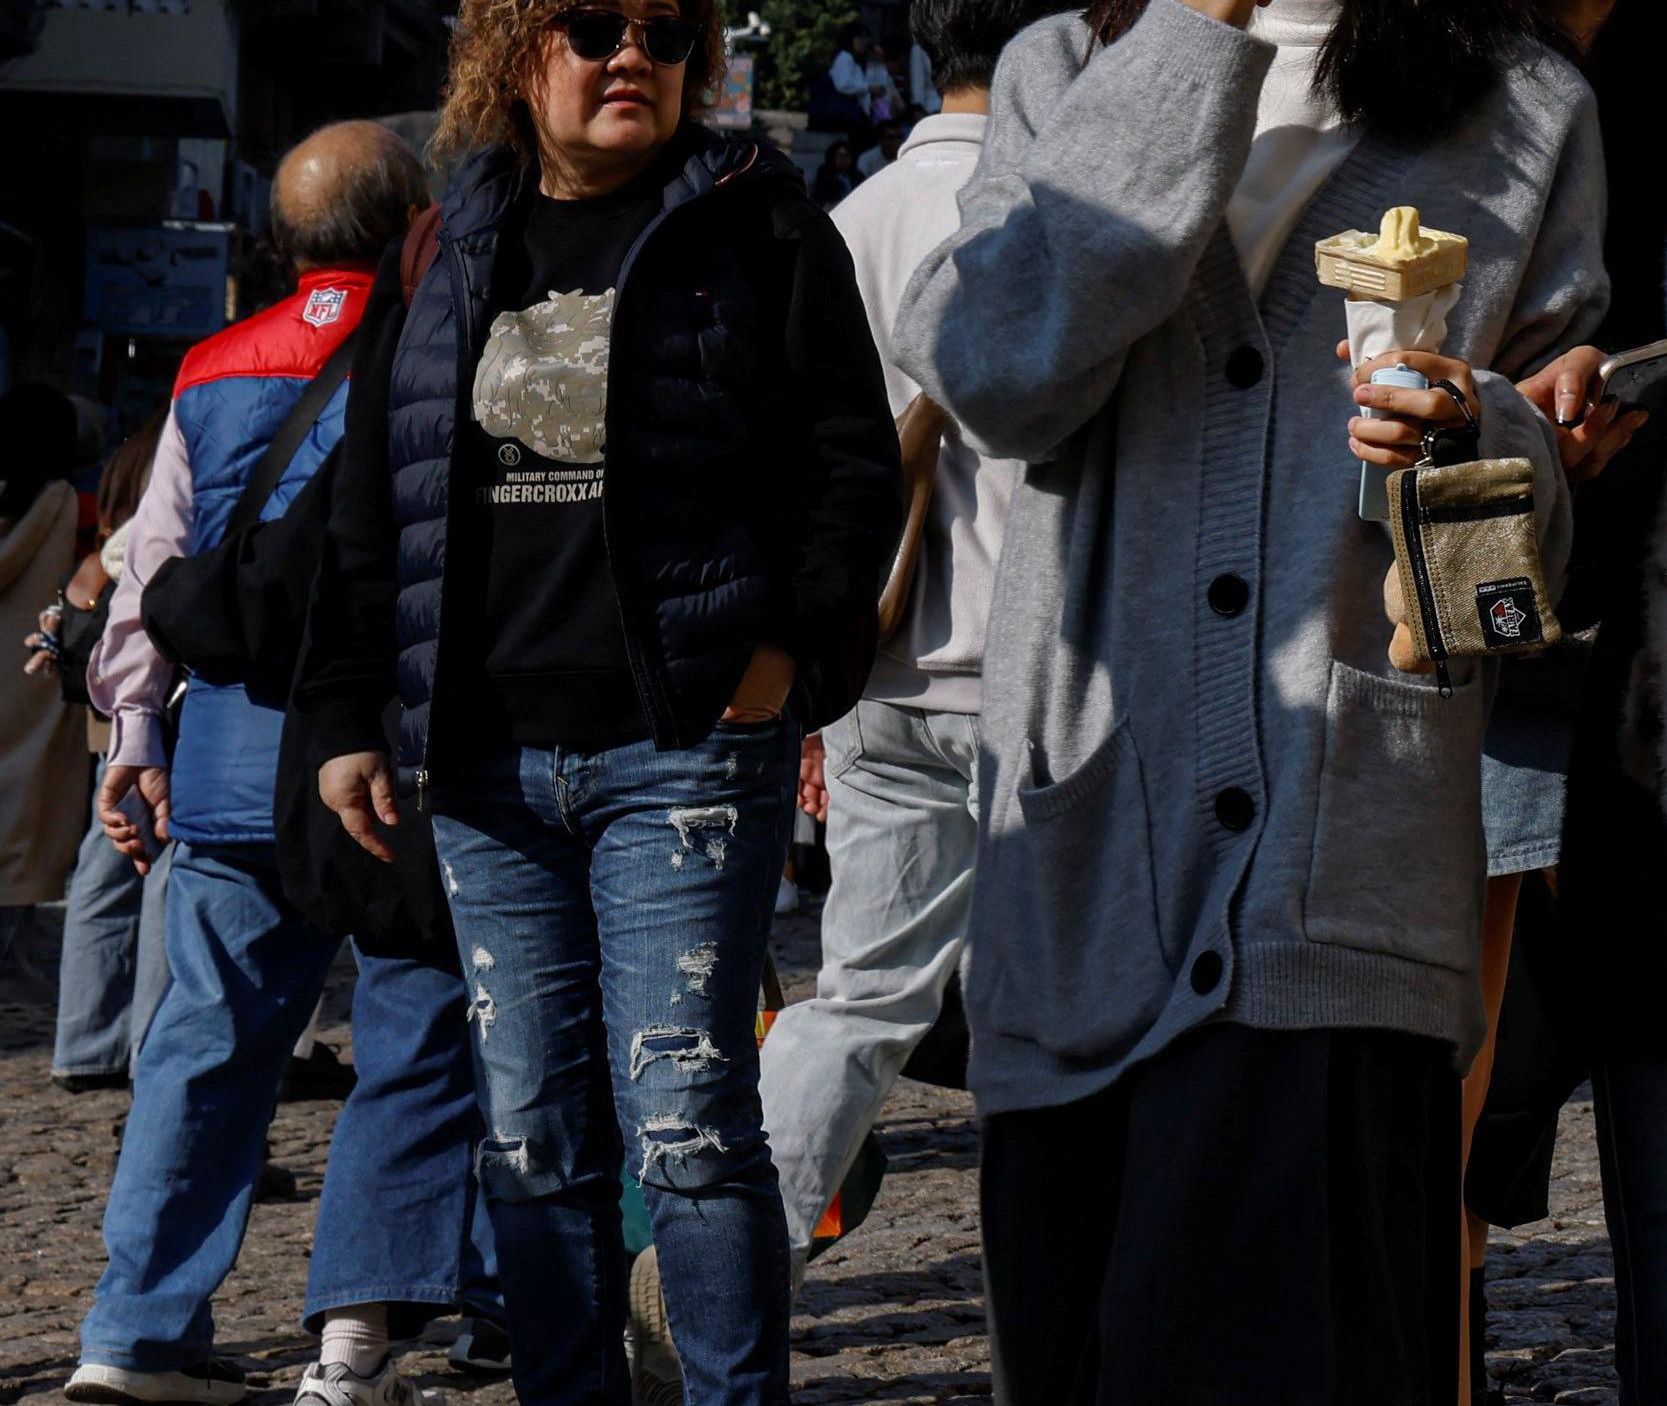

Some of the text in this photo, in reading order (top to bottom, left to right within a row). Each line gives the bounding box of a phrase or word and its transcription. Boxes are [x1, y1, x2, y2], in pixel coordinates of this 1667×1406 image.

[307, 303, 336, 320] NFL
[506, 472, 546, 483] MILITARY
[548, 470, 594, 481] COMMAND
[475, 483, 588, 504] FINGERCROXX
[1503, 597, 1520, 637] FAIRFAX
